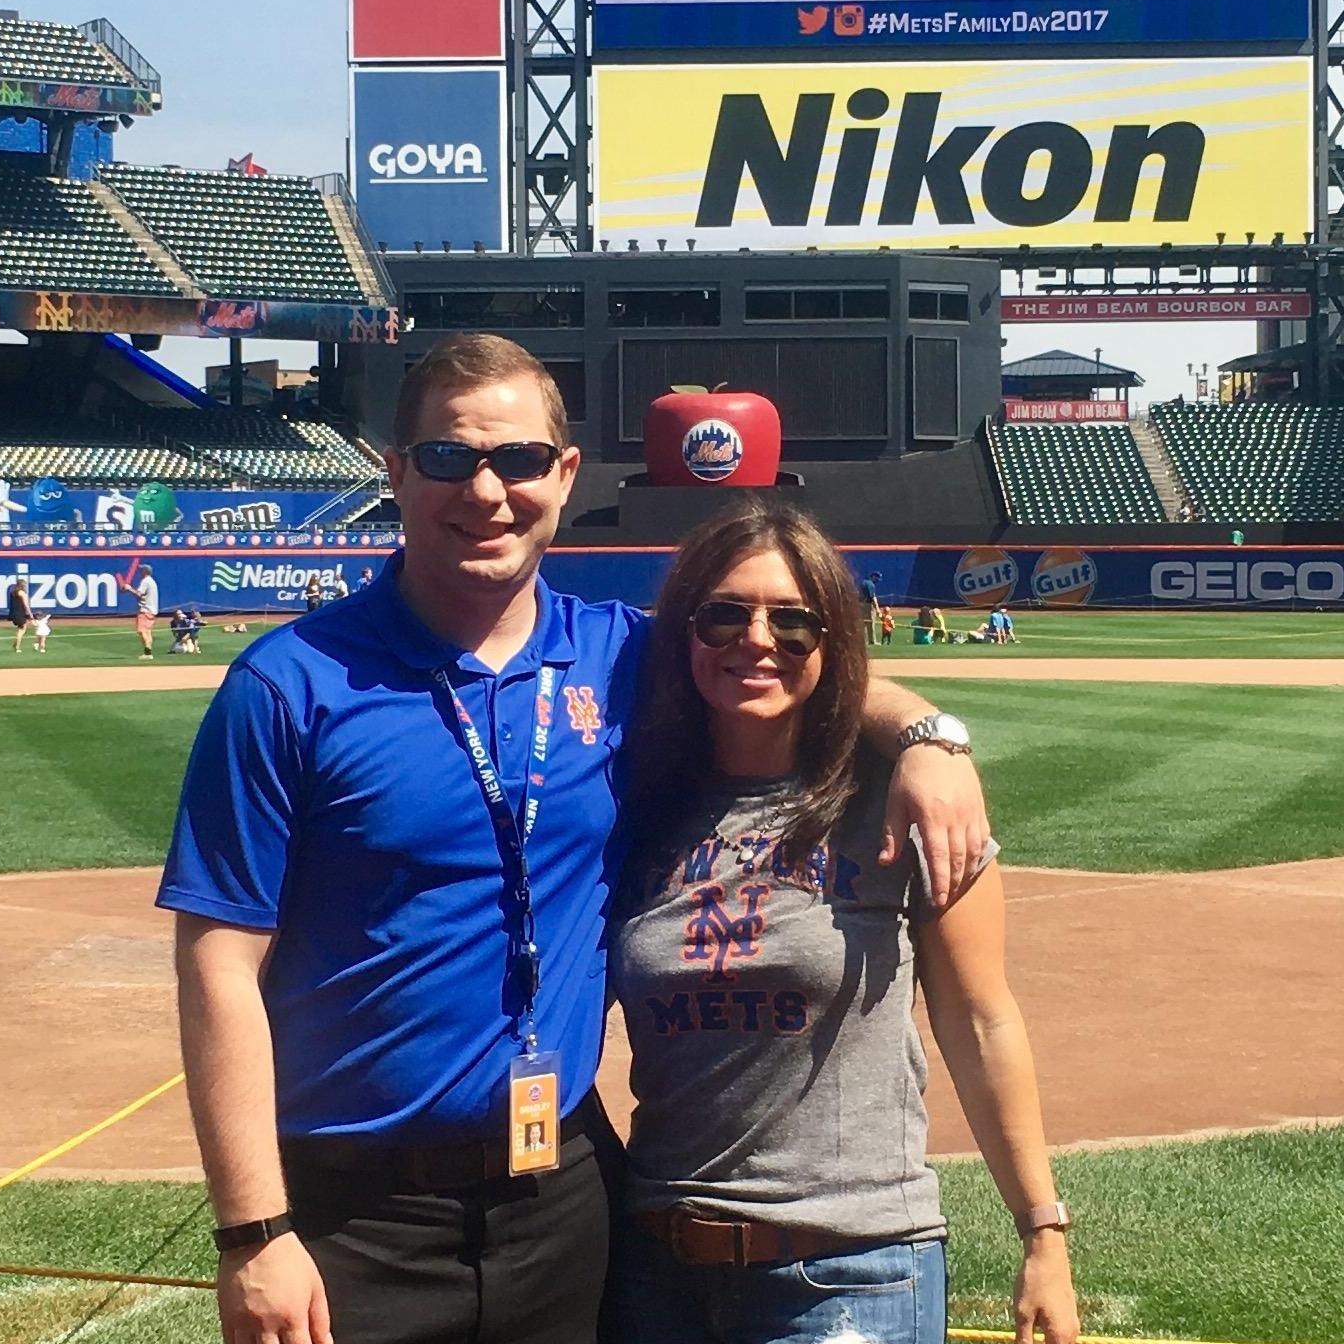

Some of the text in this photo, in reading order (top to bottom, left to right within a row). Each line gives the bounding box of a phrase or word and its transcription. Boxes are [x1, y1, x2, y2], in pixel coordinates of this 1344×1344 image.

[369, 143, 482, 178] GOYA
[694, 87, 1206, 229] Nikon
[1012, 300, 1293, 315] THE JIM BEAM BOURBON BAR
[1011, 404, 1121, 419] JIM BEAM JIM BEAM
[689, 441, 733, 462] Mets
[242, 564, 343, 588] National
[957, 563, 1014, 594] Gulf
[1035, 563, 1093, 595] Gulf
[1150, 560, 1344, 601] GEICO
[277, 590, 297, 601] Car
[540, 666, 554, 697] ORK
[465, 727, 489, 770] YORK
[533, 727, 548, 762] 2017
[479, 769, 504, 804] NEW
[646, 989, 810, 1037] METS
